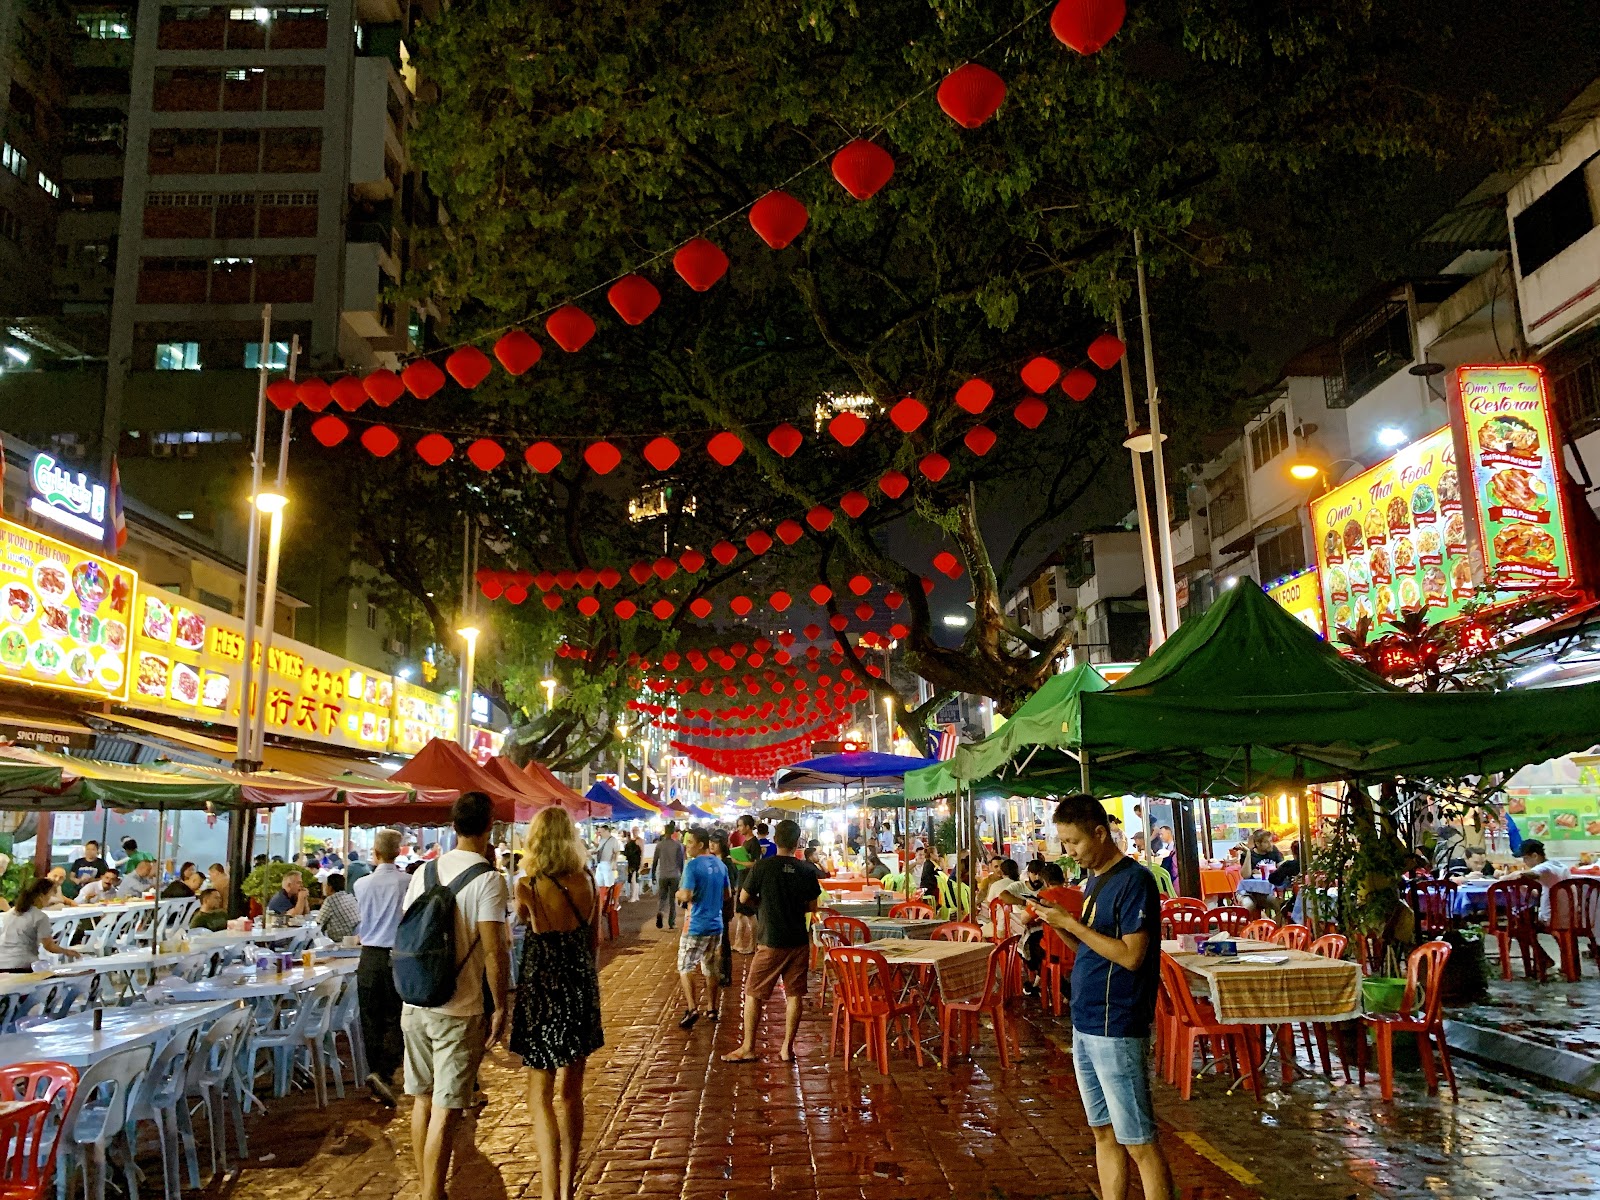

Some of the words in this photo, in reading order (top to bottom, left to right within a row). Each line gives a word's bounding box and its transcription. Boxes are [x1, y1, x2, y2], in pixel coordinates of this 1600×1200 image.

[1497, 382, 1513, 393] Thai
[1517, 382, 1539, 393] Food
[1469, 395, 1540, 414] Restoran
[1369, 477, 1394, 505] Thai
[1400, 454, 1434, 489] Food
[1502, 508, 1517, 517] BBQ
[1518, 510, 1538, 521] Prawn
[8, 534, 33, 551] WORLD
[35, 542, 51, 559] THAI
[53, 551, 71, 564] FOOD
[1282, 584, 1301, 604] FOOD
[17, 730, 37, 741] SPICY
[36, 732, 54, 744] FRIED
[53, 734, 70, 745] CRAB
